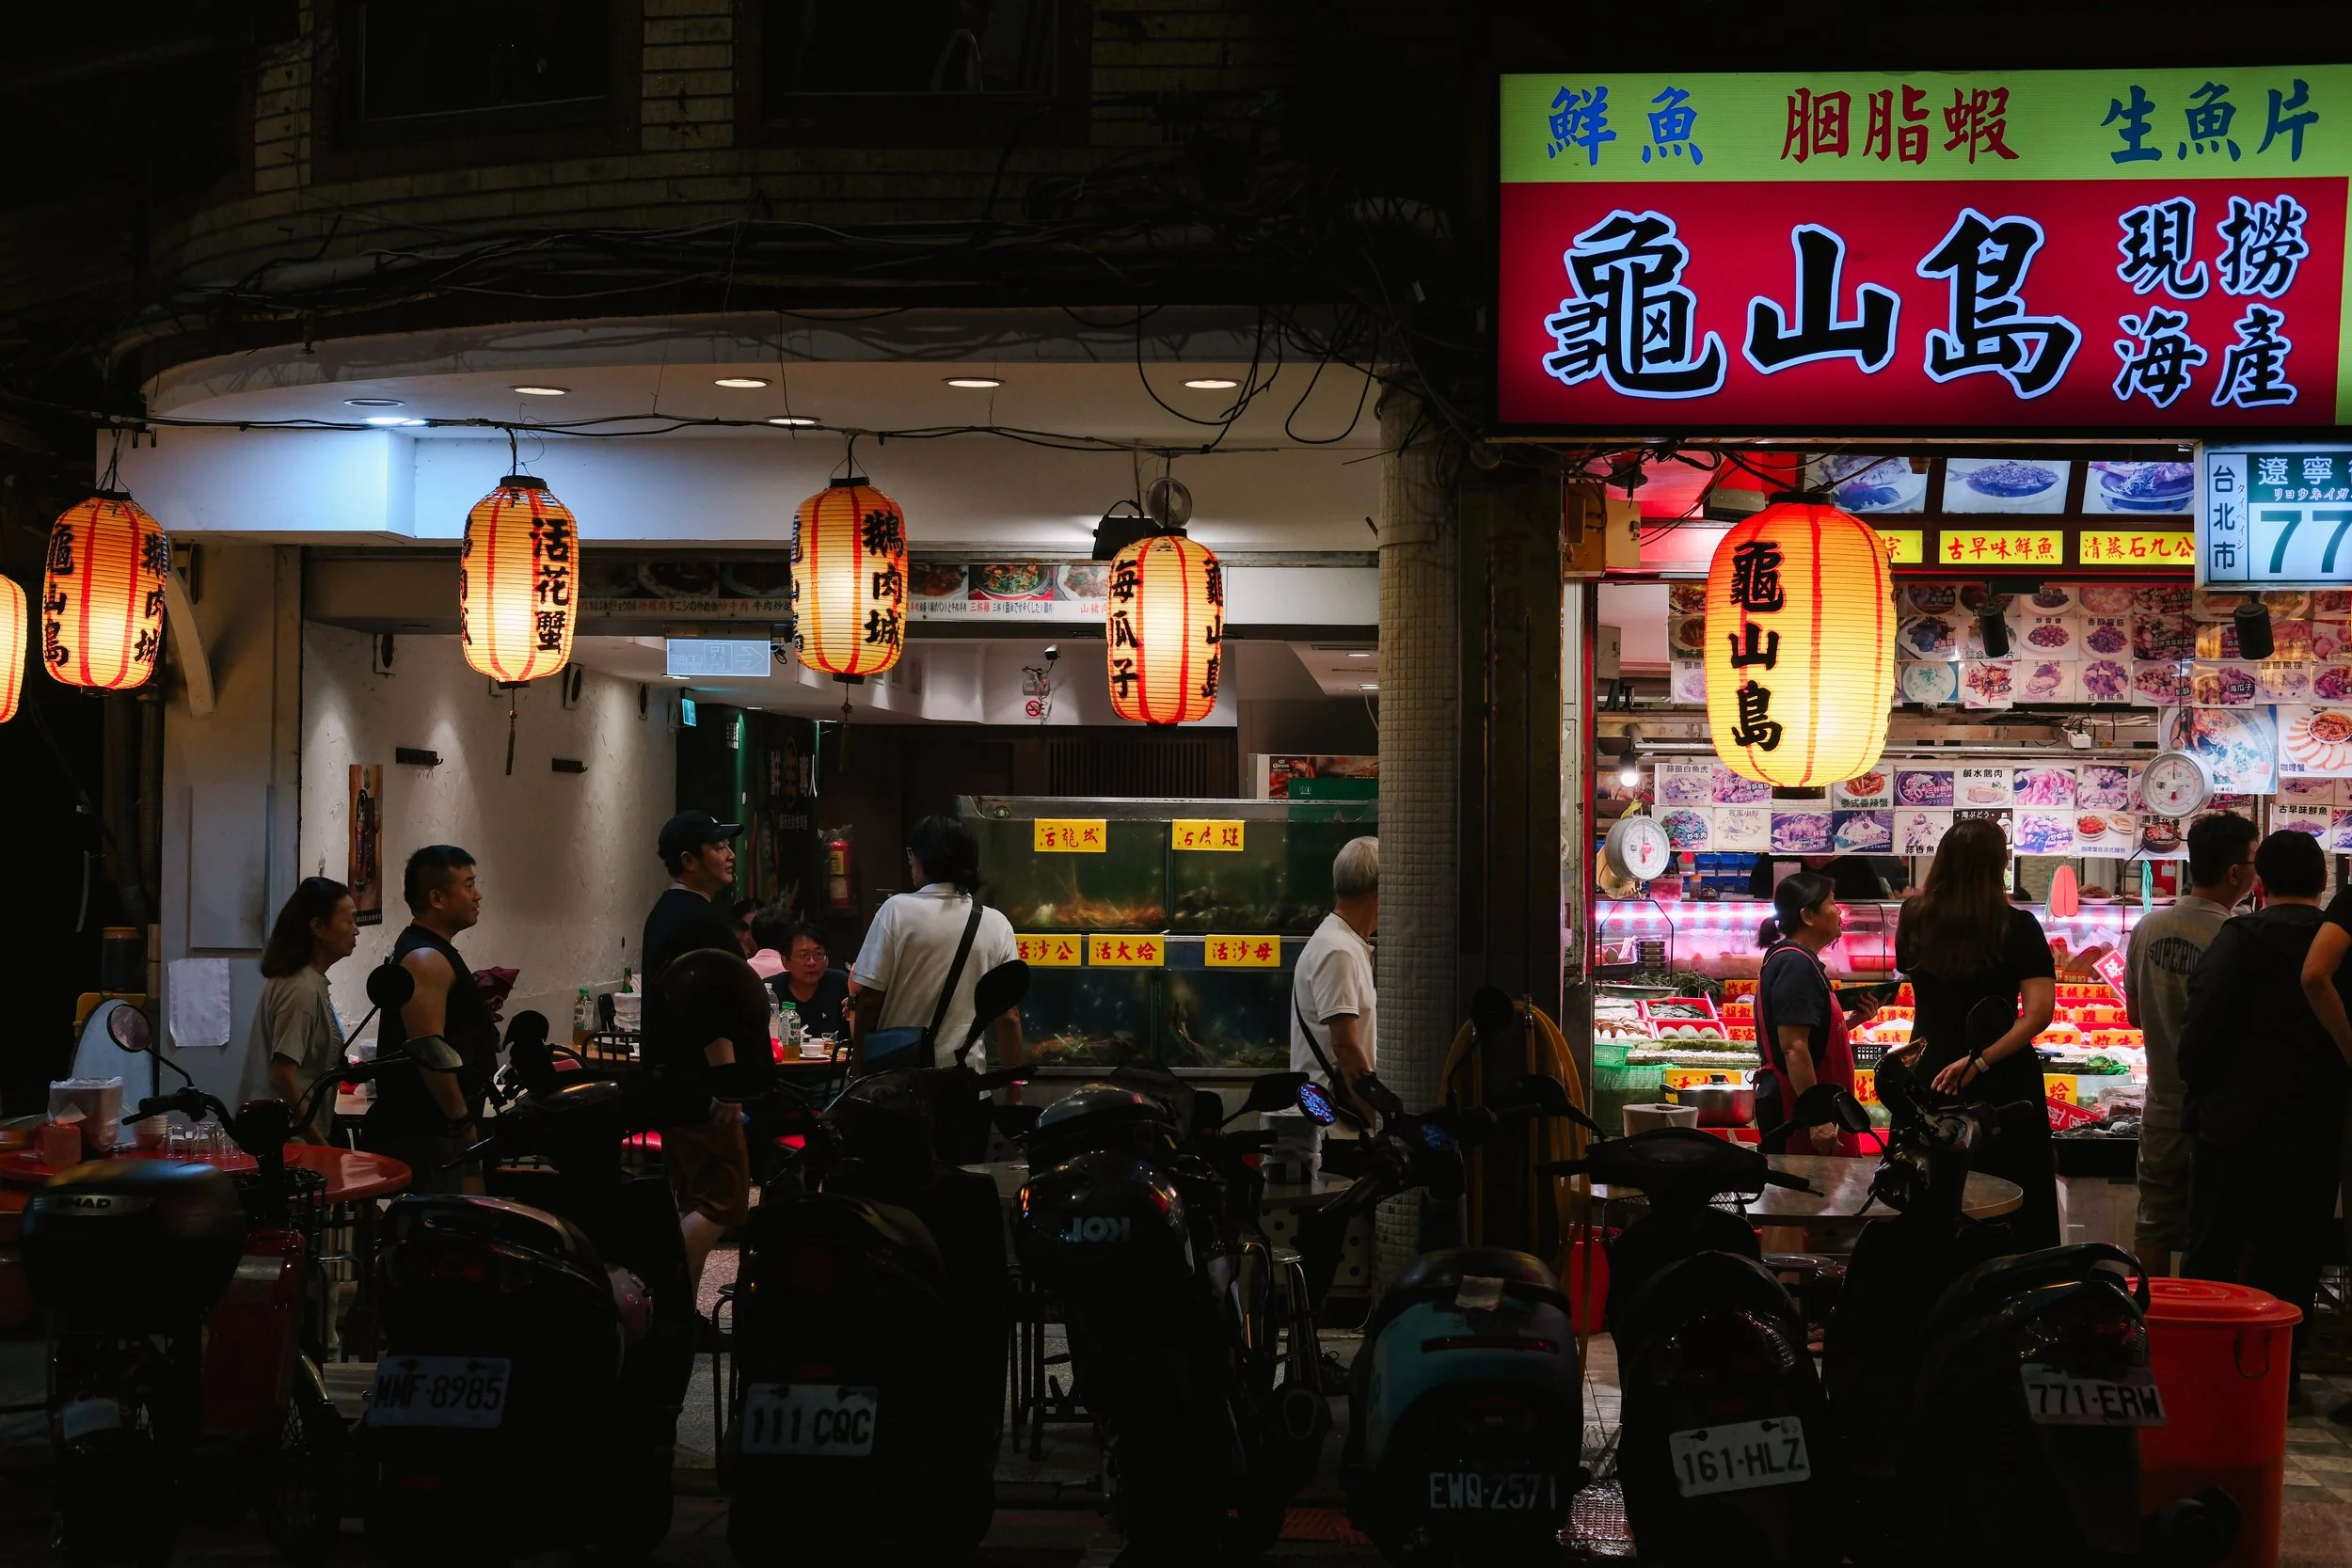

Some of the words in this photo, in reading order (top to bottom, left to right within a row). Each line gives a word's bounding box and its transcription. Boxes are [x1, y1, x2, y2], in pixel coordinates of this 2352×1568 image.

[1547, 86, 1705, 167] 鮮魚
[1781, 86, 2021, 165] 胭脂蝦
[2102, 79, 2319, 165] 生魚片
[2117, 195, 2311, 298] 現撈
[1544, 208, 2082, 400] 龜山島
[2112, 304, 2299, 410] 海產
[2258, 456, 2352, 485] 遼寧
[1947, 536, 2055, 560] 古早味鮮魚
[2084, 535, 2195, 559] 清蒸石九公
[2213, 465, 2235, 569] 台北市
[2261, 510, 2352, 573] 77
[530, 517, 570, 654] 活花蟹
[861, 510, 904, 653] 鵝肉城
[1727, 540, 1785, 752] 龜山島
[2279, 804, 2328, 816] 古早味鮮魚
[1096, 940, 1157, 960] 活大蛤
[1212, 940, 1273, 962] 活沙母
[2148, 937, 2206, 975] SUPERIO
[1428, 1471, 1558, 1512] EWQ-2571
[1681, 1436, 1806, 1486] 161-HLZ
